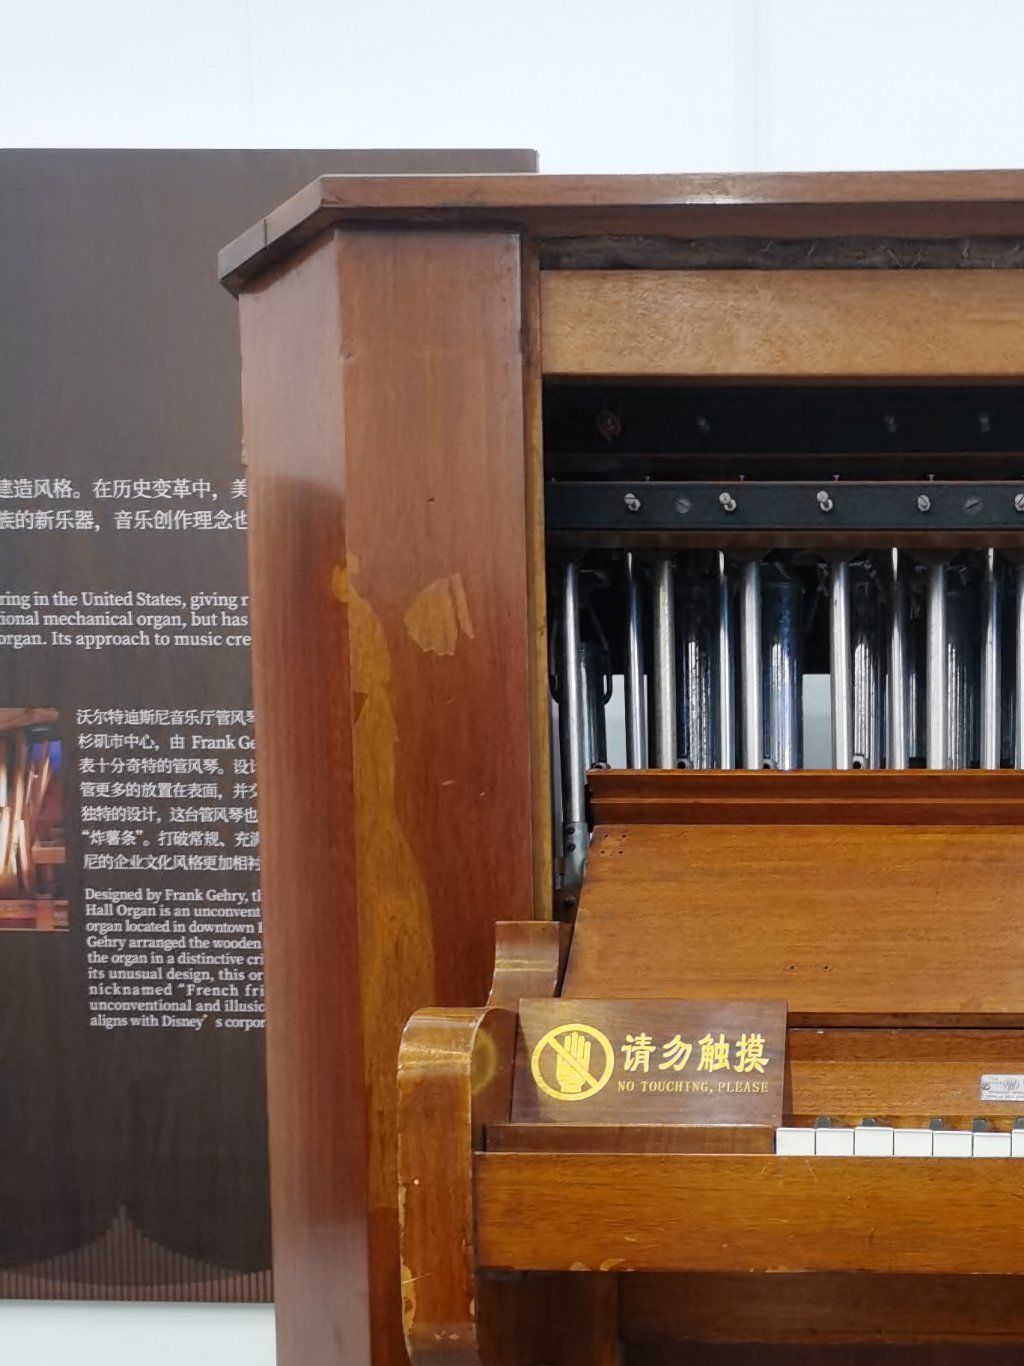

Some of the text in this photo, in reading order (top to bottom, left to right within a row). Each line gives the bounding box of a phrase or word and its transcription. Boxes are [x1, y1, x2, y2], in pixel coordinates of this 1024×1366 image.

[33, 591, 50, 606] in
[52, 590, 78, 606] the
[81, 591, 133, 606] United
[136, 592, 187, 609] States,
[190, 591, 239, 610] giving
[43, 611, 133, 626] mechanical
[136, 614, 187, 630] organ,
[190, 611, 218, 626] but
[221, 611, 248, 626] has
[51, 631, 72, 646] Its
[75, 631, 151, 649] approach
[153, 632, 170, 646] to
[174, 632, 222, 646] music
[191, 735, 235, 749] Frank
[85, 888, 142, 903] Designed
[146, 889, 162, 904] by
[165, 888, 203, 902] Frank
[206, 889, 249, 905] Gehry,
[85, 904, 113, 917] Hall
[116, 904, 156, 920] Organ
[159, 905, 171, 917] is
[174, 907, 190, 918] an
[86, 922, 123, 936] organ
[125, 920, 170, 933] located
[172, 921, 185, 933] in
[188, 920, 255, 934] downtown
[86, 935, 262, 951] Gehry arranged the wooden
[87, 952, 108, 964] the
[111, 954, 148, 967] organ
[150, 952, 164, 964] in
[167, 955, 176, 964] a
[177, 952, 244, 965] distinctive
[88, 968, 105, 980] its
[108, 968, 163, 980] unusual
[166, 968, 215, 983] design,
[218, 968, 245, 981] this
[89, 983, 173, 996] nicknamed
[90, 999, 192, 1012] unconventional
[195, 999, 221, 1012] and
[90, 1014, 128, 1029] aligns
[131, 1014, 159, 1027] with
[621, 1033, 769, 1073] 请勿触摸
[618, 1081, 769, 1094] NO TOUCHING, PLEASE
